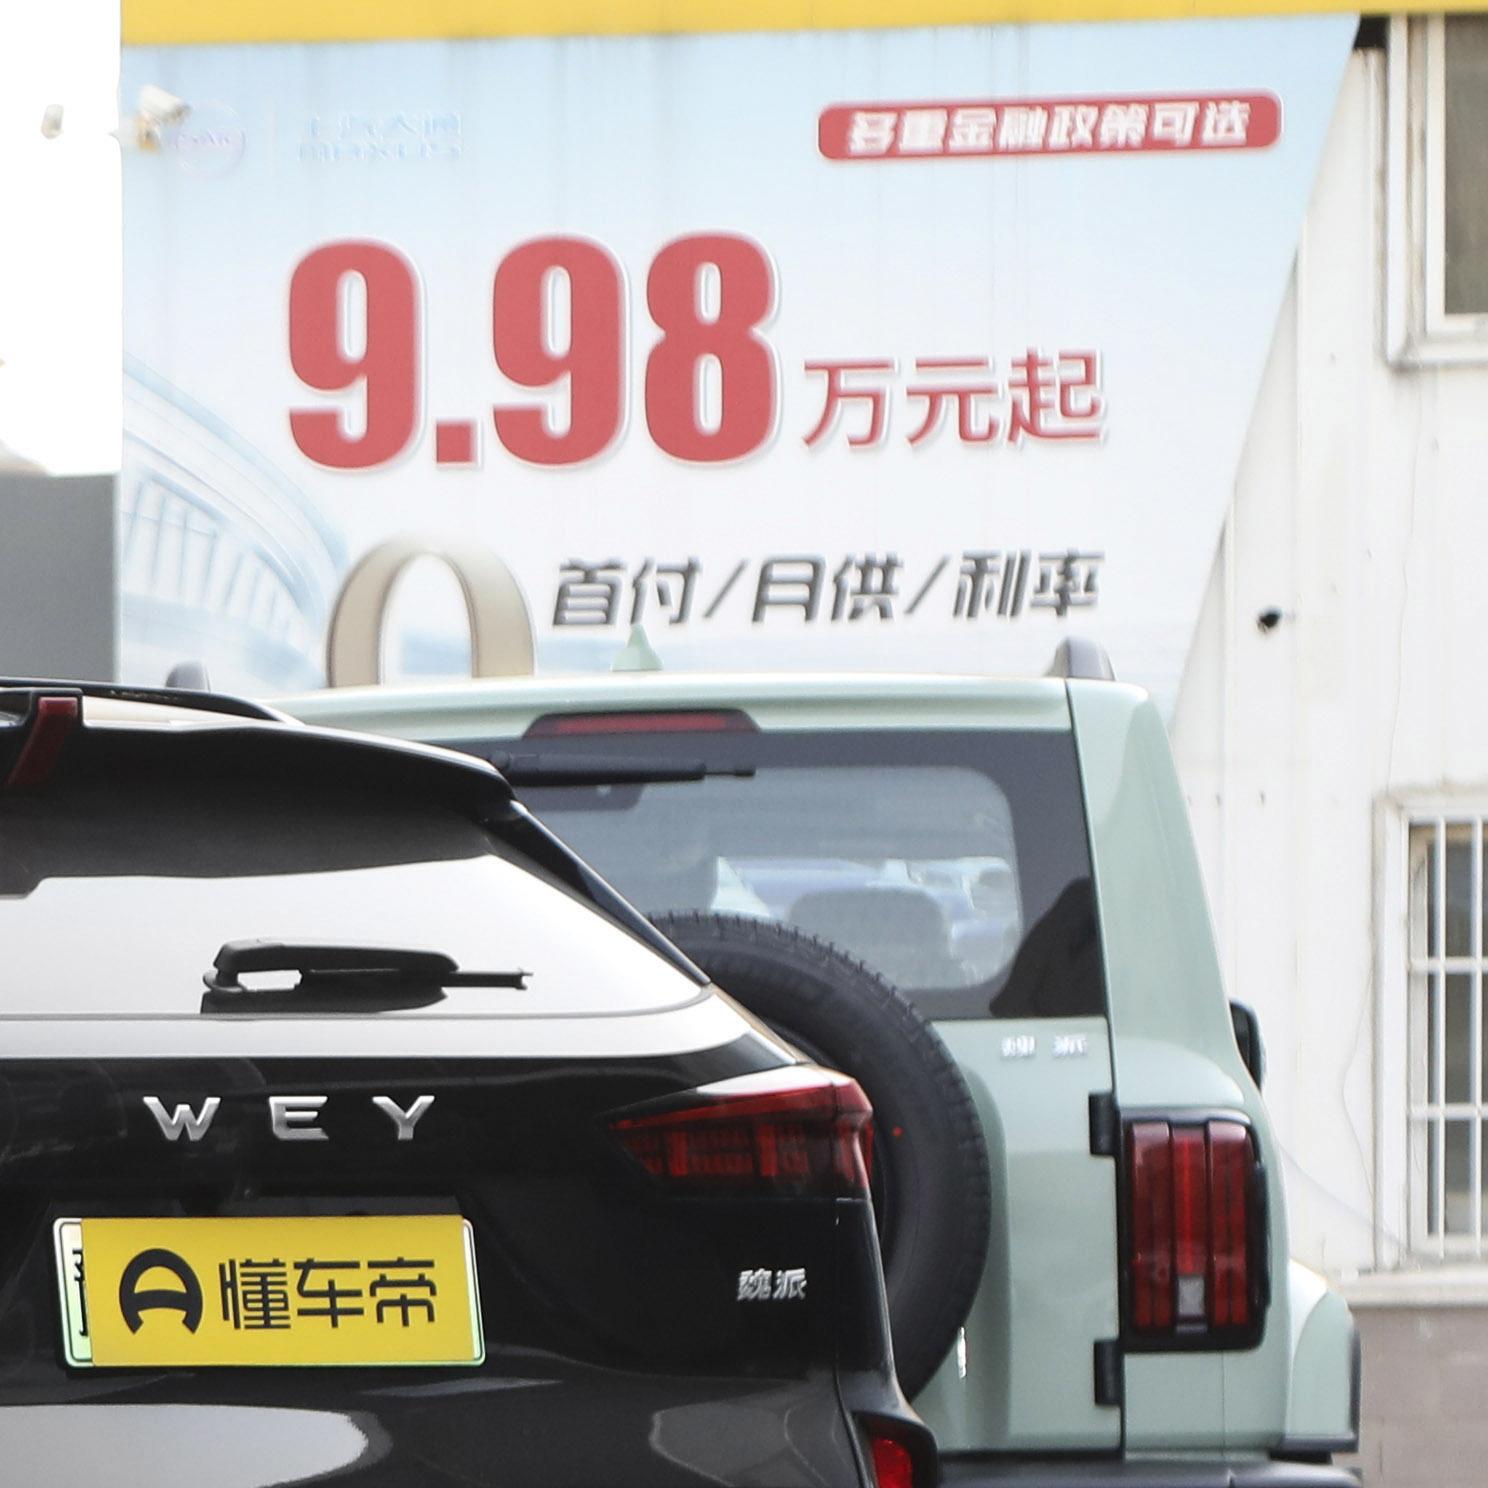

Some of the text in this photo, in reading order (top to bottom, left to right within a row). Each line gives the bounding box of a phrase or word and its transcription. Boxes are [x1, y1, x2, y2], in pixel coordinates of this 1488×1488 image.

[847, 101, 1251, 155] 多重金融政策可选
[288, 231, 1104, 469] 9.98 万元起
[143, 1095, 435, 1142] WEY
[218, 1257, 437, 1330] 懂车帝
[737, 1268, 807, 1300] 魏派
